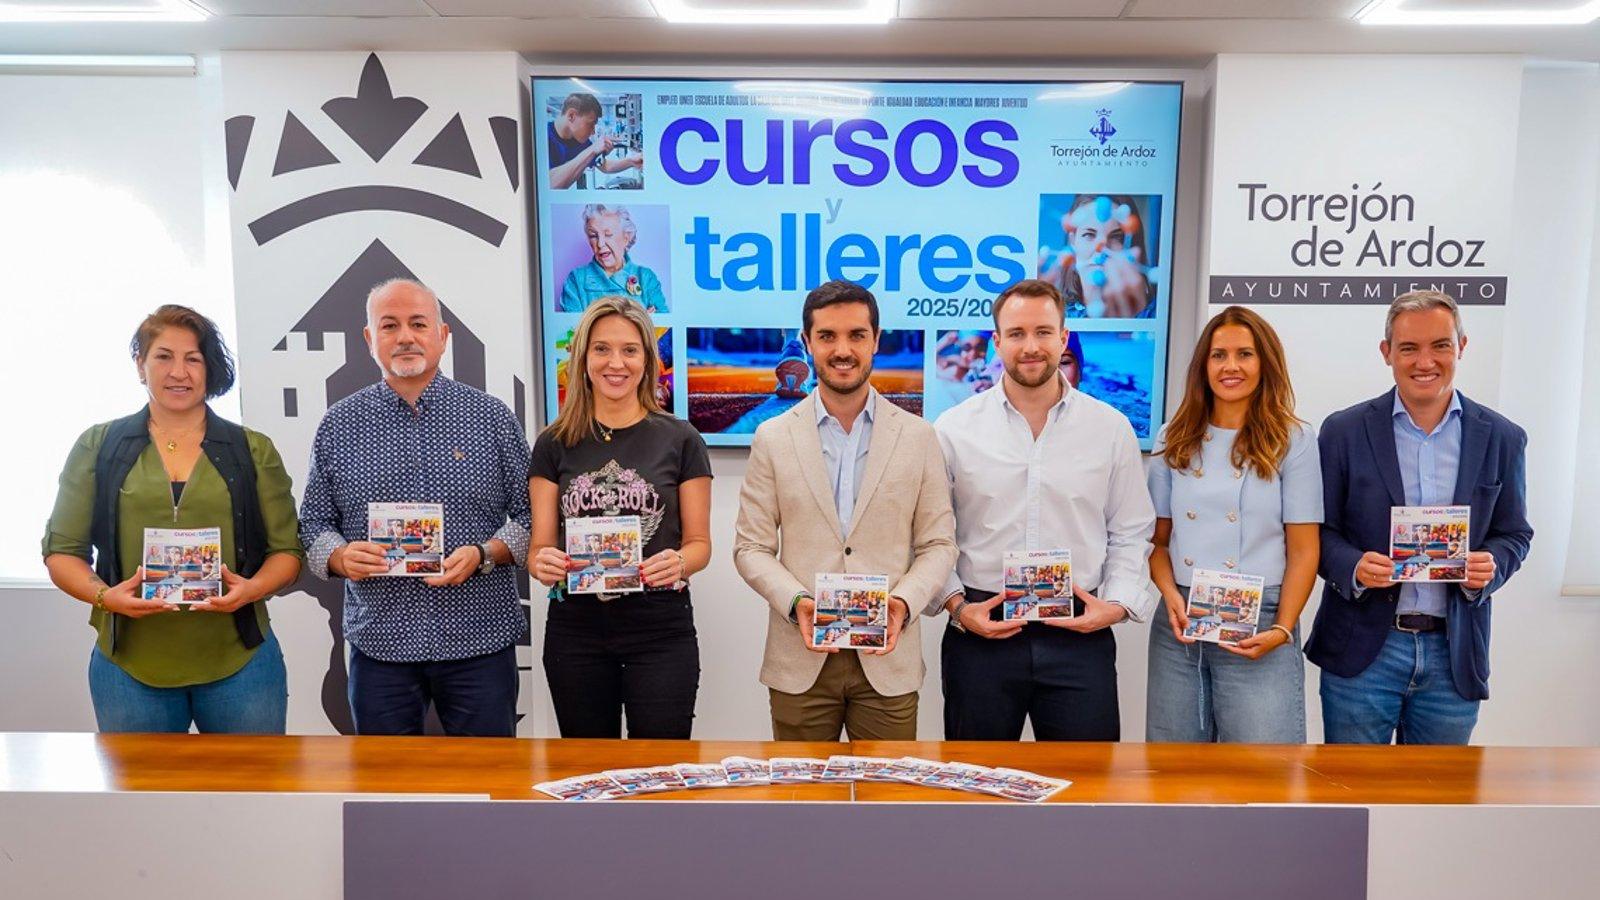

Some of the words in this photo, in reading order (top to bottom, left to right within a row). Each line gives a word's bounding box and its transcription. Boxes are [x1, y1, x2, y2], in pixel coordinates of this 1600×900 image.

[657, 95, 679, 105] EMPLEO
[695, 95, 717, 105] ESCUELA
[887, 97, 913, 107] IGUALDAD
[974, 97, 1000, 108] MAYORES
[1001, 97, 1028, 108] JUVENTUD
[659, 117, 1020, 189] cursos
[1050, 145, 1100, 160] Torrejón
[1102, 145, 1118, 157] de
[1121, 145, 1156, 158] Ardoz
[825, 198, 844, 224] y
[1238, 182, 1415, 234] Torrejón
[685, 213, 1026, 294] talleres
[1291, 226, 1344, 267] de
[1355, 226, 1486, 267] Ardoz
[907, 298, 994, 318] 2025/20
[561, 486, 605, 517] ROCK
[617, 484, 660, 516] ROLL
